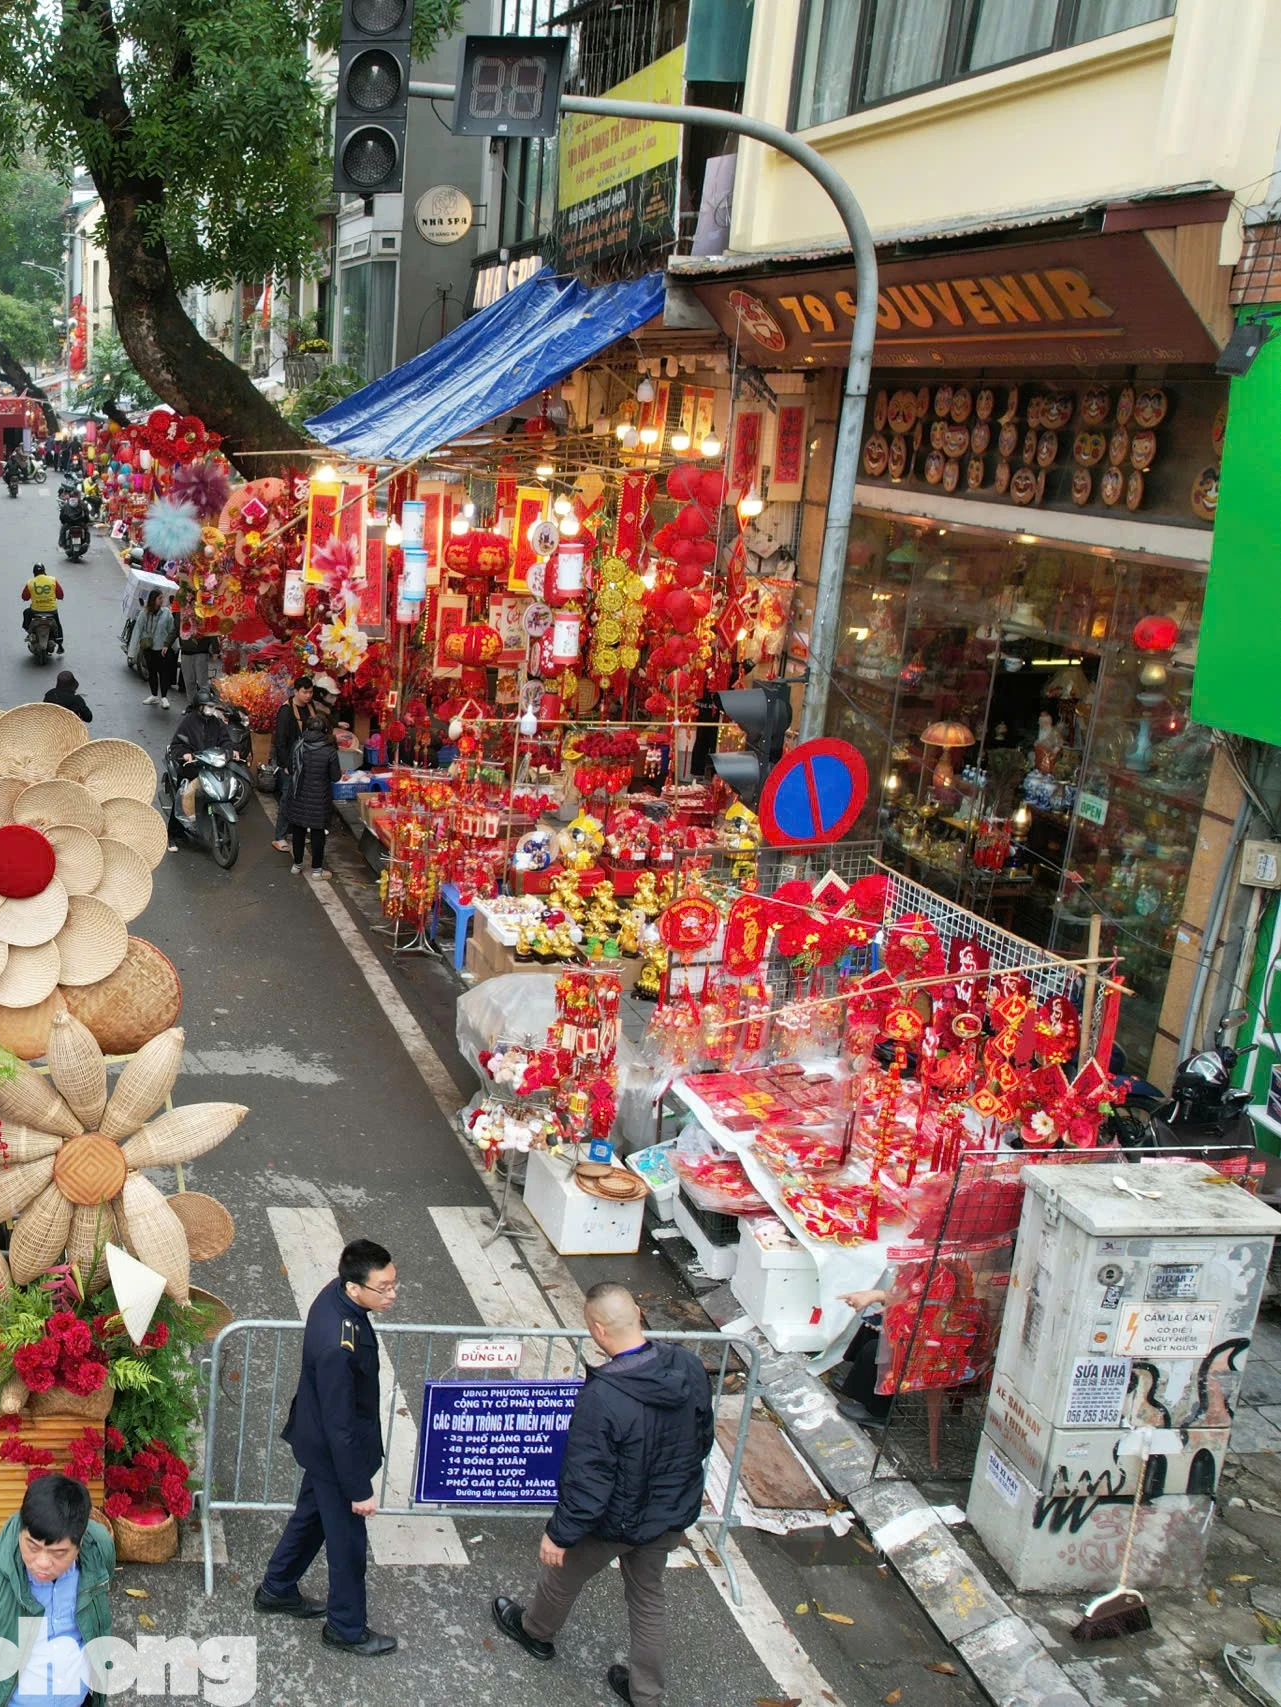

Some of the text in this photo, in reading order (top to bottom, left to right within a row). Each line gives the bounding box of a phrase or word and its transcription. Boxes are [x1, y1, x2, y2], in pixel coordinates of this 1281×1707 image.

[447, 217, 467, 225] SPA
[777, 294, 835, 333] 79
[34, 582, 51, 595] be
[1081, 801, 1102, 820] OPEN
[463, 1389, 489, 1398] UBND
[454, 1398, 480, 1409] CÔNG
[481, 1399, 494, 1408] TY
[510, 1397, 535, 1408] PHẦN
[536, 1396, 564, 1408] ĐỒNG
[433, 1409, 451, 1431] CÁC
[451, 1408, 475, 1432] ĐIỂM
[475, 1411, 503, 1432] TRÔNG
[503, 1414, 516, 1431] XE
[515, 1408, 540, 1431] MIỄN
[539, 1410, 556, 1431] PHÍ
[1066, 1409, 1120, 1423] 056 255 3456
[449, 1434, 464, 1442] 32
[465, 1432, 489, 1443] PHỐ
[490, 1433, 521, 1442] HÀNG
[523, 1432, 550, 1442] GIẤY
[448, 1445, 462, 1453] 48
[464, 1444, 488, 1454] PHỐ
[522, 1444, 553, 1454] XUÂN
[448, 1456, 461, 1464] 14
[496, 1455, 527, 1465] XUÂN
[446, 1467, 460, 1475] 37
[462, 1466, 493, 1476] HÀNG
[495, 1468, 526, 1478] LƯỢC
[446, 1476, 469, 1487] PHỐ
[525, 1478, 556, 1487] HÀNG
[455, 1488, 481, 1498] Đường
[482, 1488, 497, 1498] dây
[497, 1489, 519, 1498] nóng:
